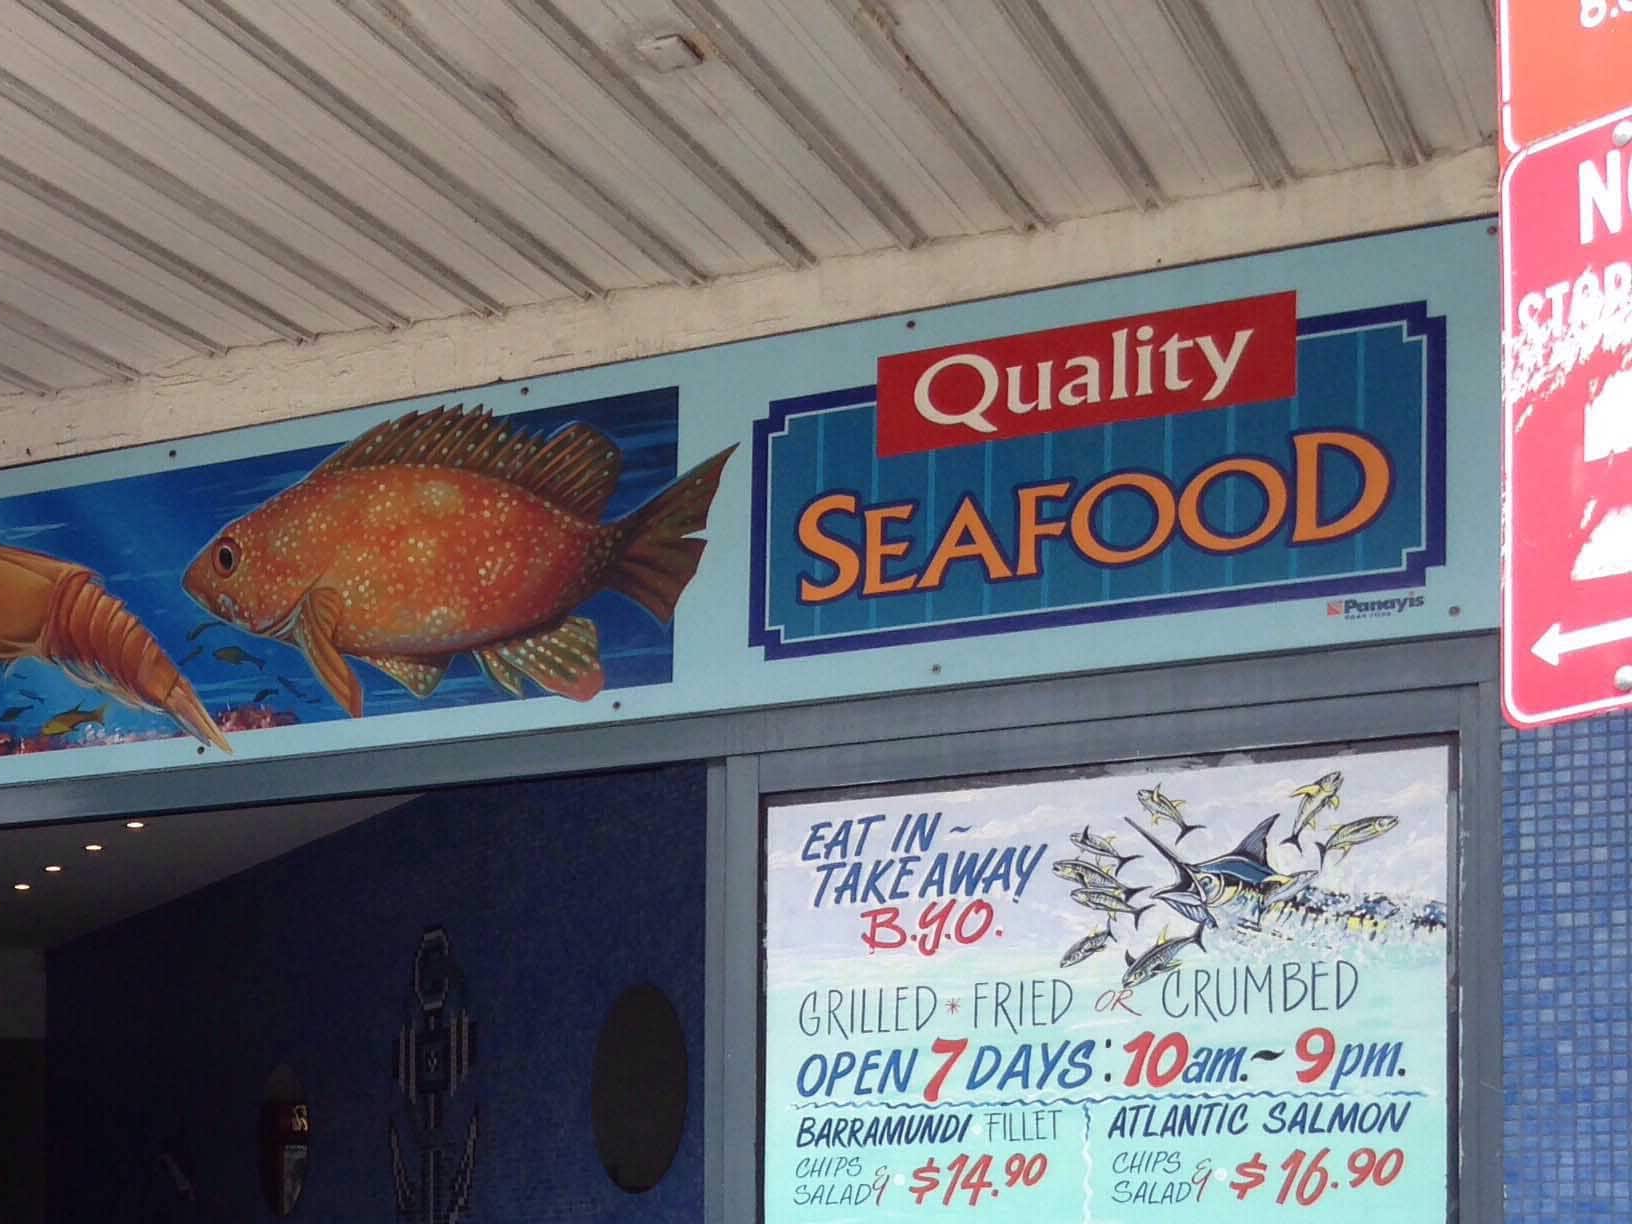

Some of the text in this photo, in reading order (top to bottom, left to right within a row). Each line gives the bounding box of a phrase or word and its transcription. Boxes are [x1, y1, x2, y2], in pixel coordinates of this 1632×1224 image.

[913, 324, 1255, 433] Quality
[796, 429, 1393, 605] SEAFOOD
[801, 812, 942, 861] EAT IN
[799, 960, 1359, 1040] GRILLED FRIED OR CRUMBED
[796, 1048, 918, 1097] OPEN
[923, 1037, 968, 1102] 7
[796, 1109, 1064, 1148] BARRAMUNDI FILLET
[1107, 1101, 1412, 1139] ATLANTIC SALMON
[795, 1156, 863, 1178] CHIPS
[908, 1151, 1049, 1207] $14.90
[1112, 1150, 1182, 1175] CHIPS
[1229, 1147, 1405, 1207] $16.90
[793, 1182, 872, 1206] SALAD
[1111, 1180, 1192, 1205] SALAD
